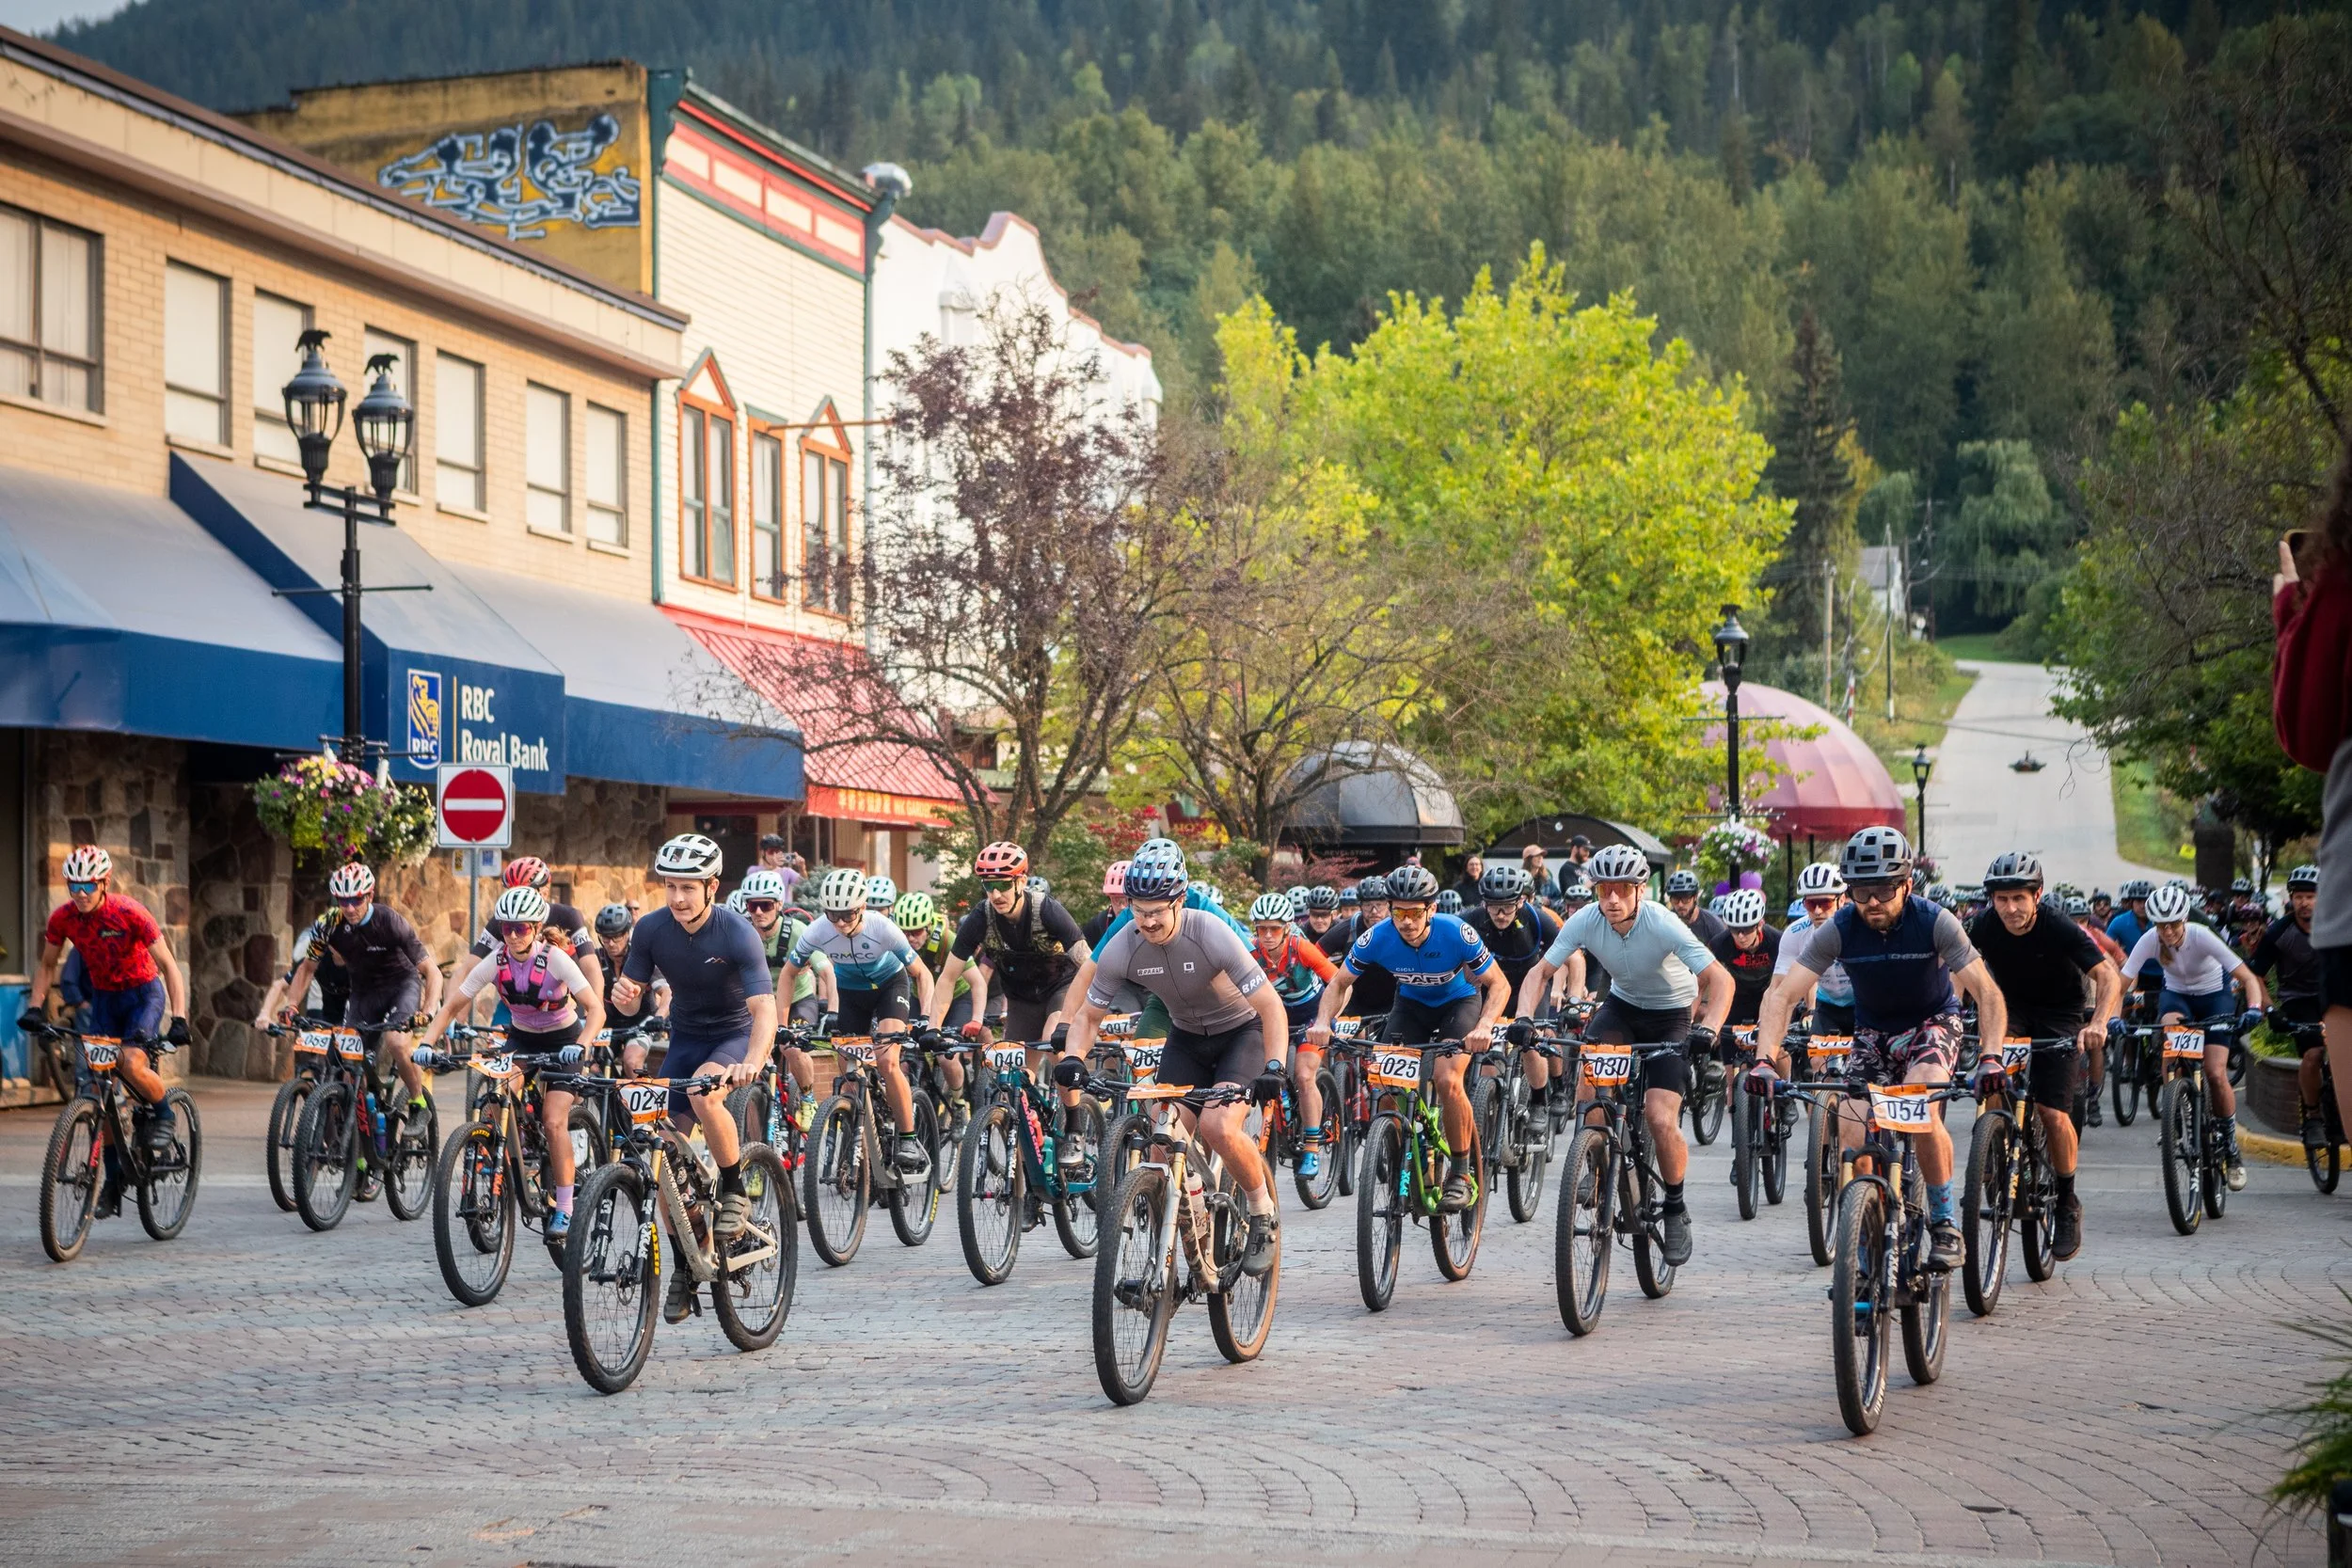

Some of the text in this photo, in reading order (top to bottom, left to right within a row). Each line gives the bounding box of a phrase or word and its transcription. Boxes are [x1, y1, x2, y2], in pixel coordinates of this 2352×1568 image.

[461, 685, 495, 723] RBC
[412, 738, 437, 761] RBC
[461, 729, 549, 771] Royal Bank
[1105, 1022, 1129, 1035] 097
[305, 1034, 328, 1047] 059
[340, 1037, 362, 1052] 120
[484, 1056, 511, 1071] 23
[994, 1051, 1025, 1068] 046
[1383, 1057, 1419, 1078] 025
[1595, 1057, 1629, 1078] 030
[629, 1090, 668, 1113] 024
[1886, 1099, 1927, 1121] 054
